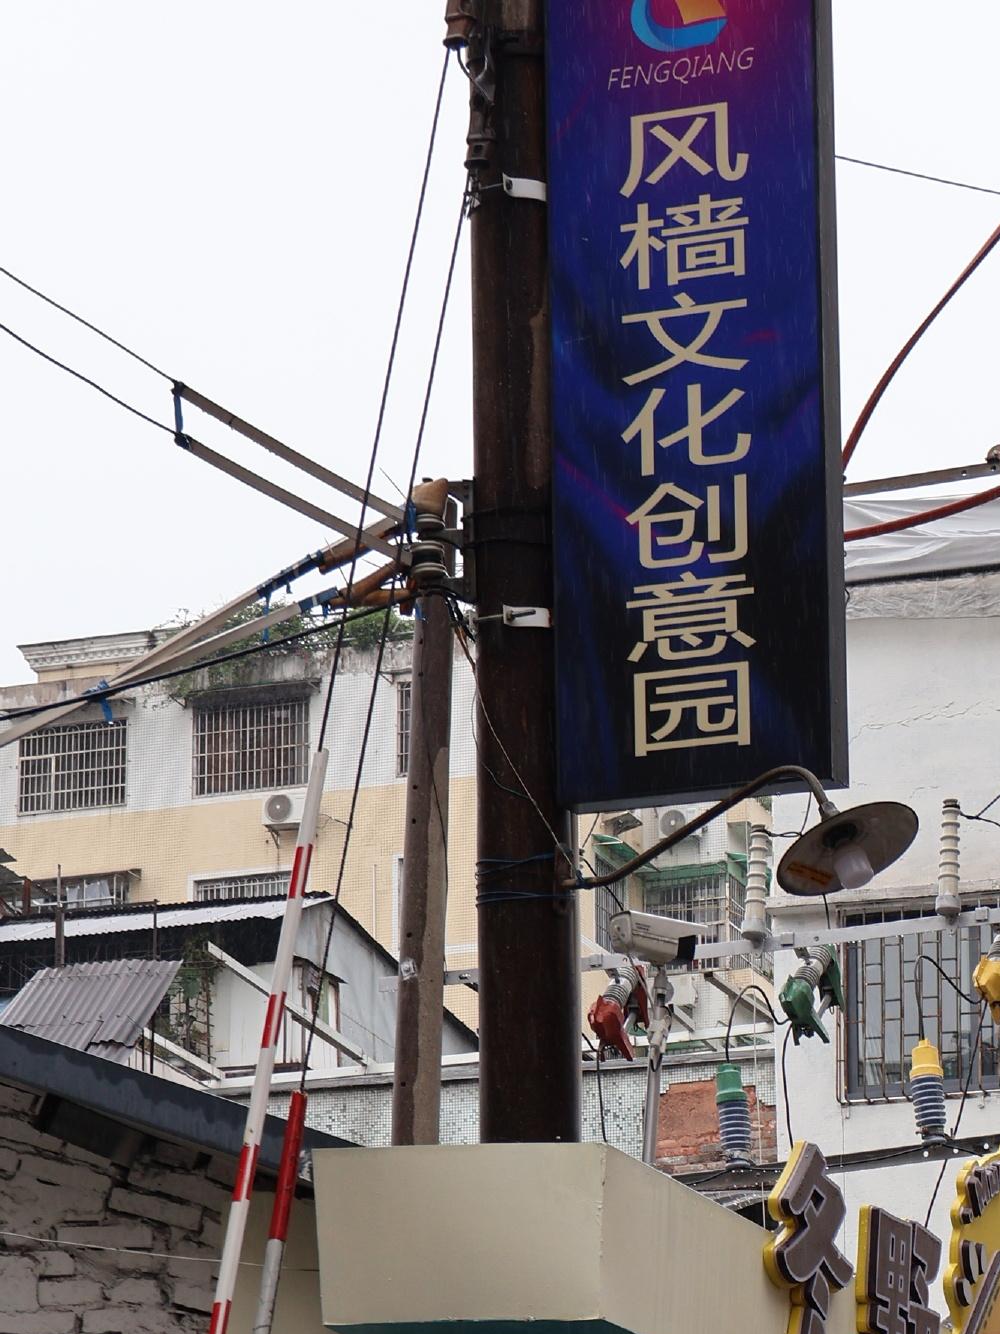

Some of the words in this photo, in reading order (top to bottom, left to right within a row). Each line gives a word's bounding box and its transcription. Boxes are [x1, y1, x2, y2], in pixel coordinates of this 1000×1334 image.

[607, 46, 754, 91] FENGQIANG
[620, 101, 756, 758] 风樯文化创意园
